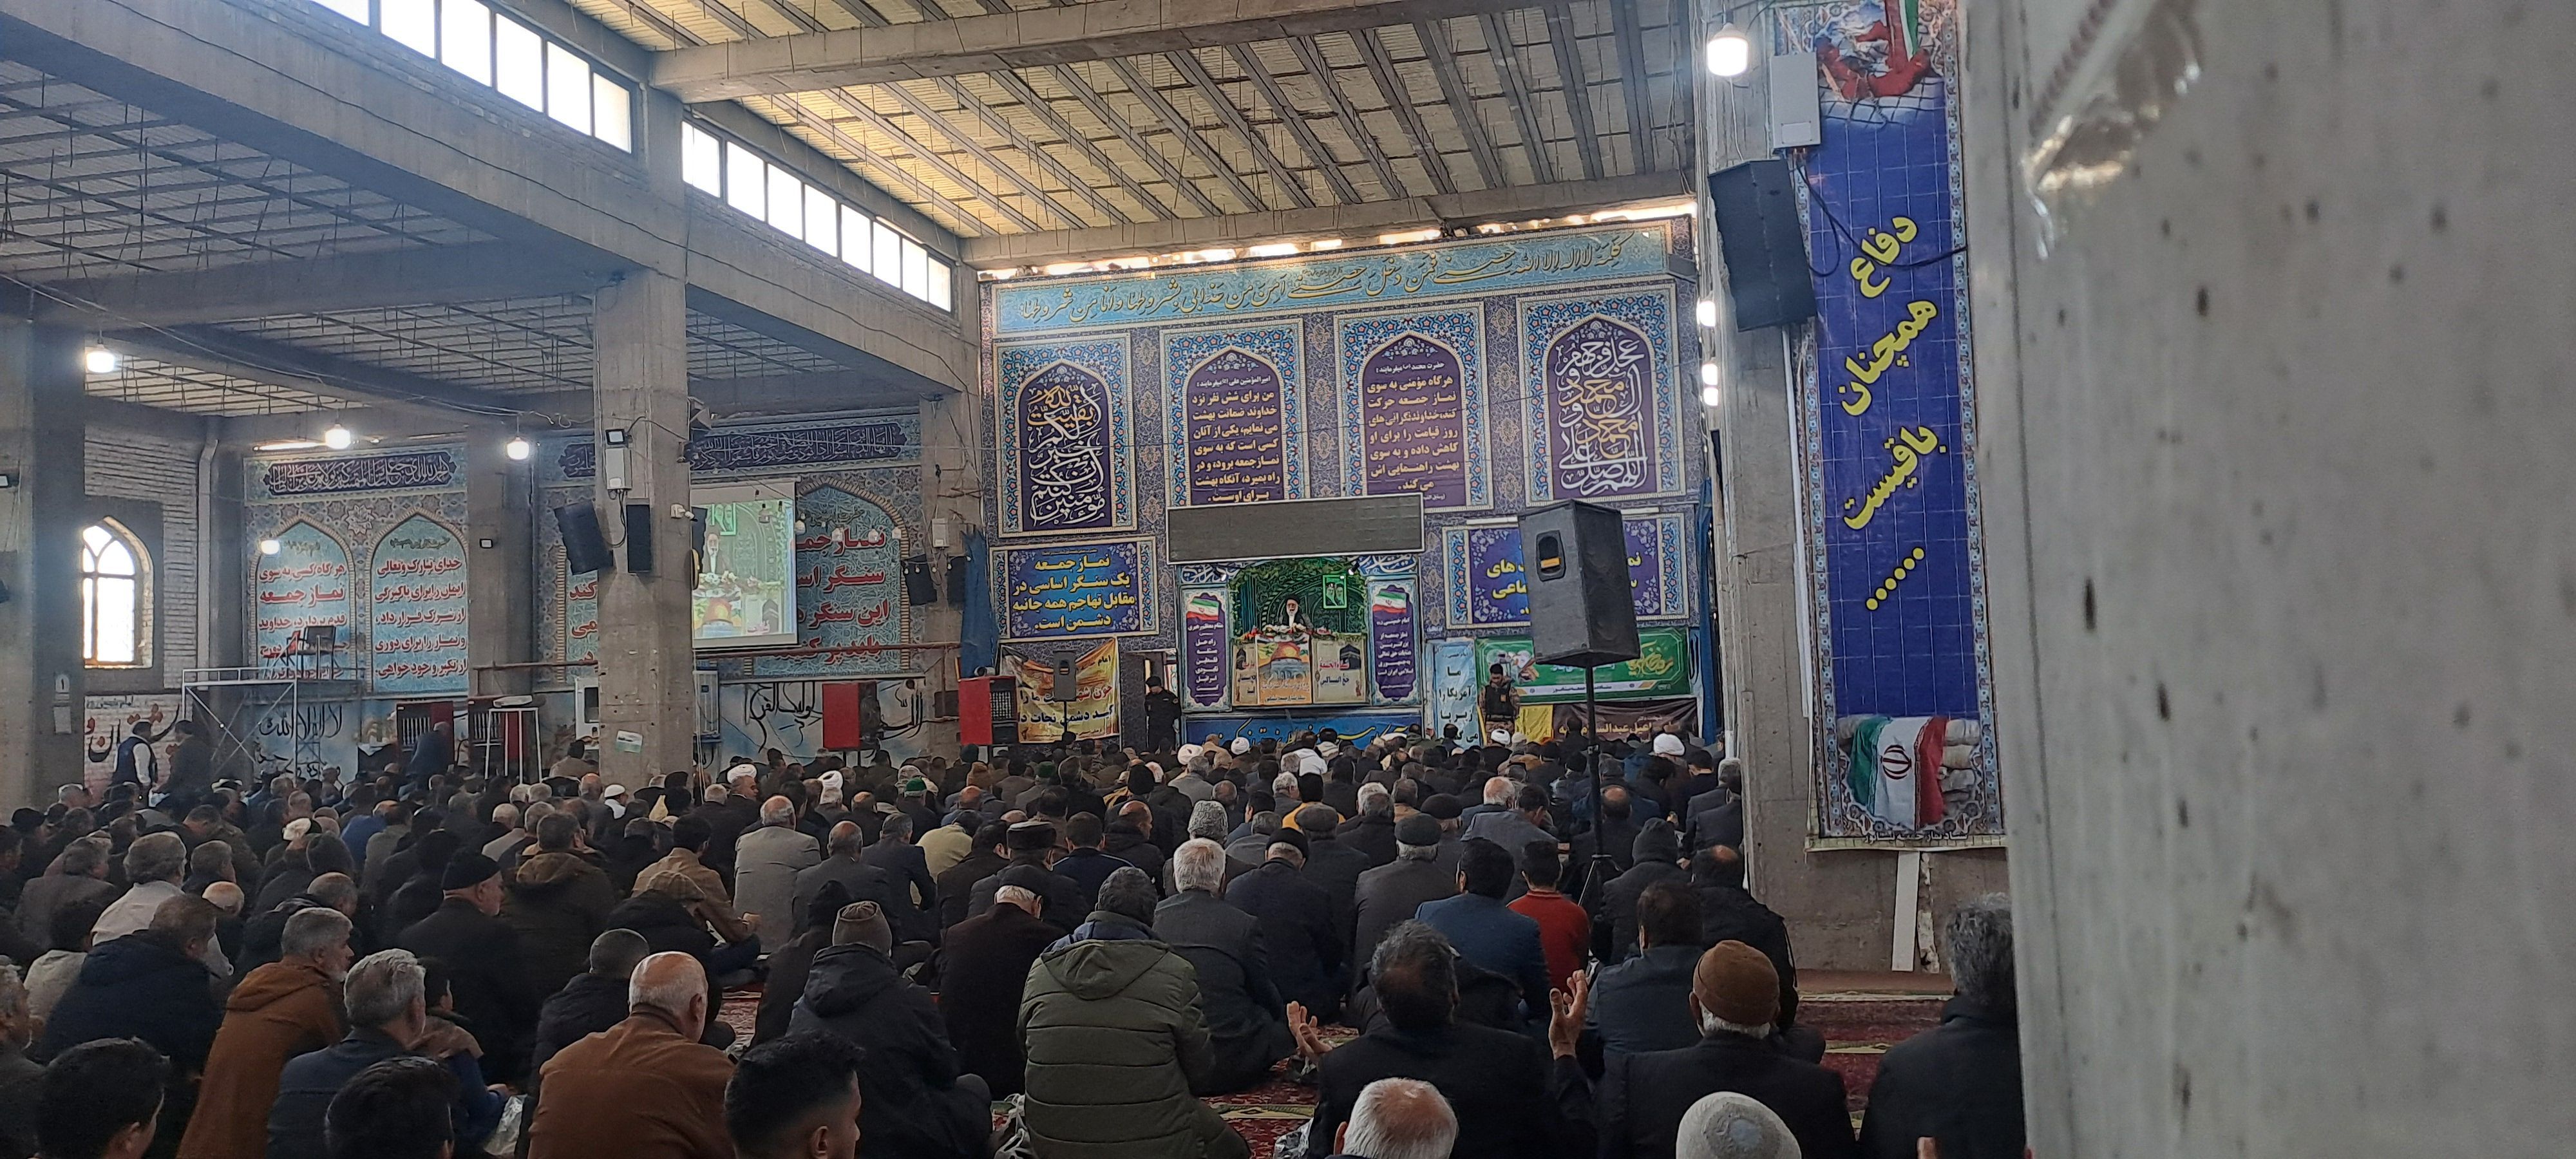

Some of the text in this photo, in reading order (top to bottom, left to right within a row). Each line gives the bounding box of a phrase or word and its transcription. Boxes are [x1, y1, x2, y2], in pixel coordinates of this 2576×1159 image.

[1850, 216, 1918, 298] دفاع
[1838, 300, 1938, 417] همچنان
[1367, 376, 1426, 393] مؤمنی به سوی
[1192, 390, 1275, 406] من برای شش نفر نزد
[1367, 391, 1457, 410] نماز جمعه حرکت
[1192, 404, 1278, 421] خداوند ضمانت بهشت
[1412, 410, 1440, 424] خداوند
[1193, 424, 1213, 439] آنان
[1213, 424, 1221, 438] از
[1222, 423, 1240, 437] یکی
[1264, 423, 1279, 435] می
[1369, 426, 1459, 444] روز قیامت را برای او
[1194, 437, 1279, 456] کسی است که به سوی
[1370, 442, 1459, 460] کاهش داده و به سوی
[1195, 461, 1206, 473] در
[1206, 462, 1213, 471] و
[1235, 458, 1257, 469] جمعه
[1256, 454, 1280, 469] نماز
[1370, 459, 1461, 478] بهشت راهنمایی اش
[1195, 475, 1218, 487] بهشت
[1267, 471, 1281, 485] راه
[1420, 480, 1435, 491] می
[1843, 426, 1947, 531] باقیست
[1243, 489, 1270, 502] برای
[408, 558, 436, 576] تبارک
[435, 557, 462, 575] خدای
[1034, 553, 1111, 573] نماز جمعه
[260, 570, 280, 583] سوی
[823, 564, 886, 592] سنگر
[1012, 571, 1130, 596] یک سنگر اساسی در
[260, 583, 346, 608] نماز جمعه
[412, 584, 432, 602] برای
[441, 582, 465, 599] ایمان
[1012, 592, 1135, 612] مقابل تهاجم همه جانبه
[397, 609, 423, 628] قرار
[424, 608, 456, 625] شرک
[456, 607, 466, 623] از
[808, 598, 891, 629] این سنگر
[1034, 612, 1112, 631] دشمن است.
[375, 634, 467, 654] و نماز را برای دوری
[458, 658, 468, 675] از
[1097, 655, 1111, 666] امام
[431, 665, 438, 676] و
[1447, 666, 1461, 676] ما
[1020, 690, 1029, 704] را
[1439, 688, 1446, 702] را
[1030, 713, 1056, 724] نجات
[1454, 709, 1473, 722] زیر
